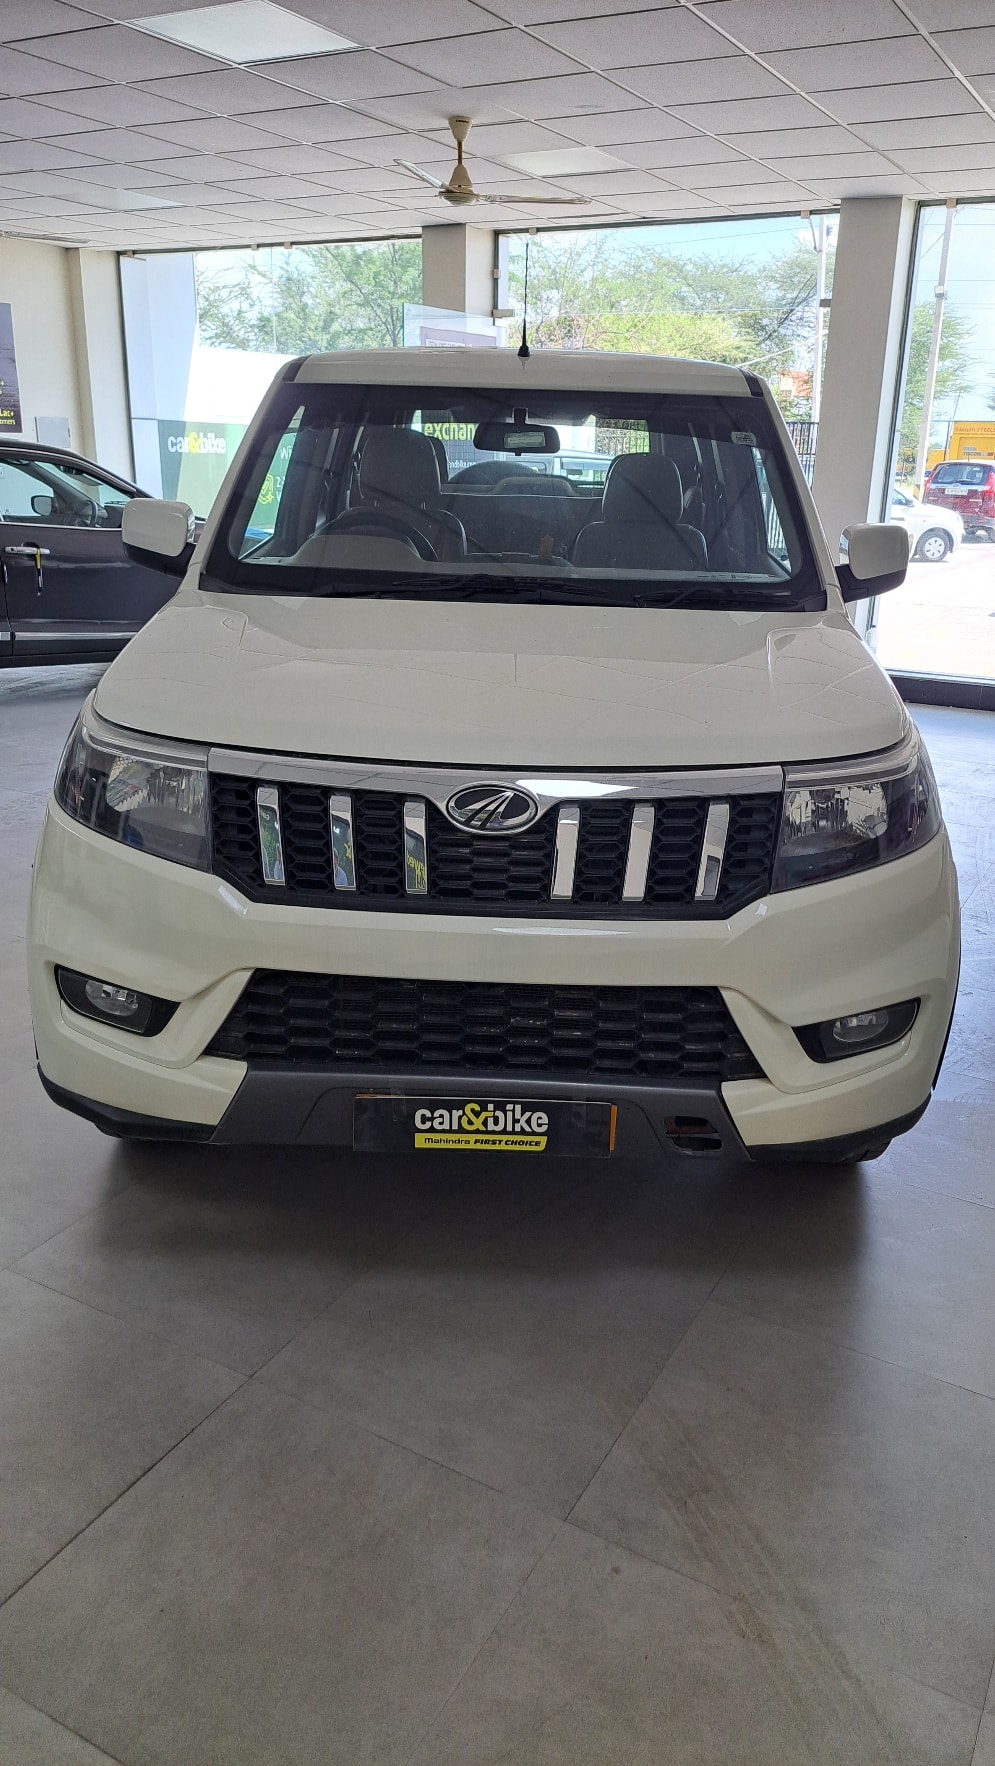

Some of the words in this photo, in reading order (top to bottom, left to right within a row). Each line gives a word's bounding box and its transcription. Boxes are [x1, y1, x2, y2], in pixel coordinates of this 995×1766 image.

[167, 431, 227, 454] car&bike
[415, 1102, 549, 1133] car&bike
[424, 1137, 471, 1145] Mahindra
[473, 1138, 503, 1146] FIRST
[504, 1139, 542, 1147] CHOICE
